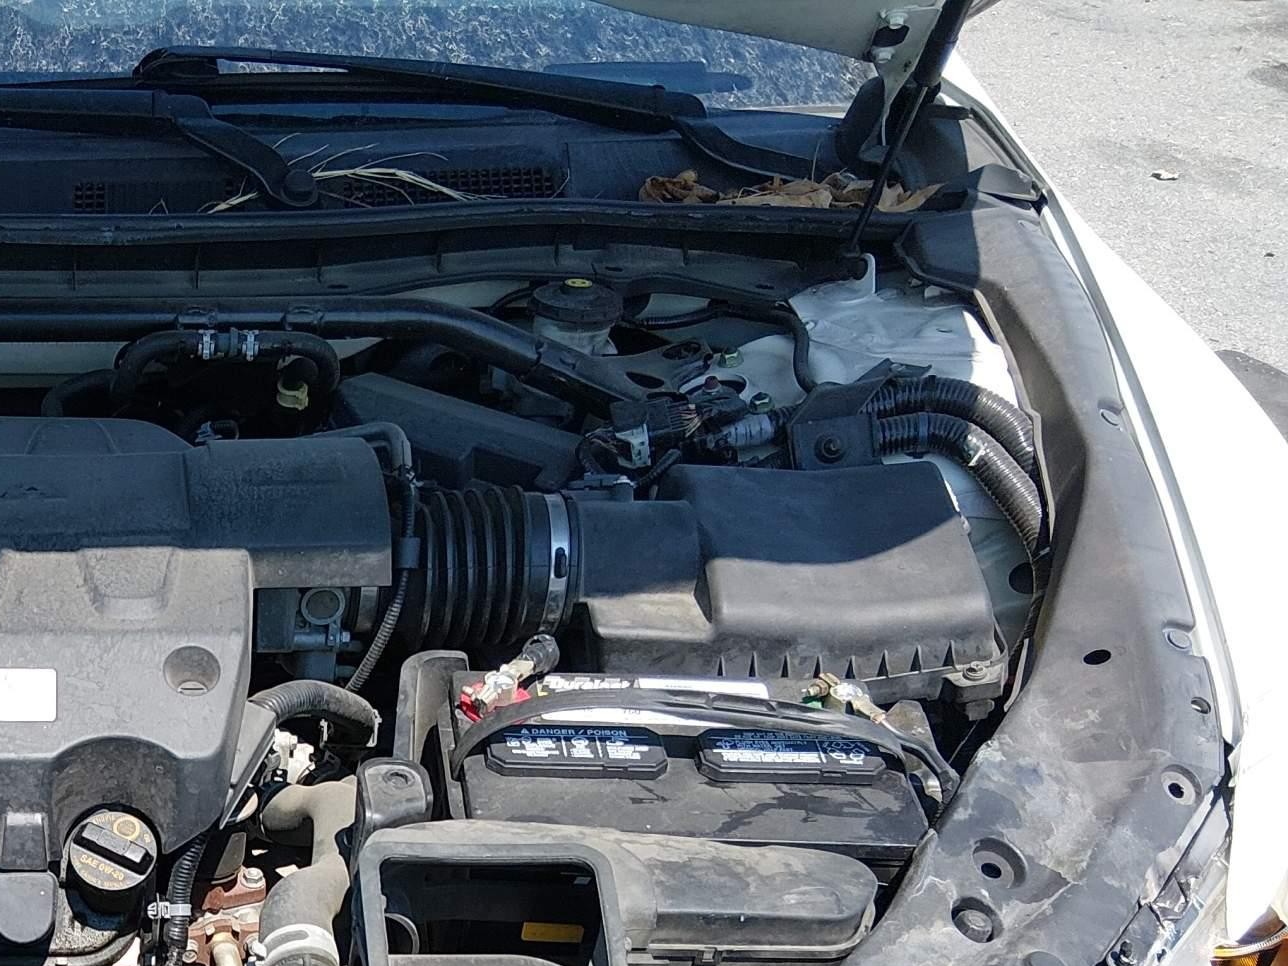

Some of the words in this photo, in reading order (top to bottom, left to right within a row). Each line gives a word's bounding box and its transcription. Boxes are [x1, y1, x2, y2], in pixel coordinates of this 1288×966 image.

[532, 728, 576, 736] DANGER
[587, 729, 628, 737] POISON
[80, 854, 99, 869] SAE
[98, 862, 125, 881] 0W-20
